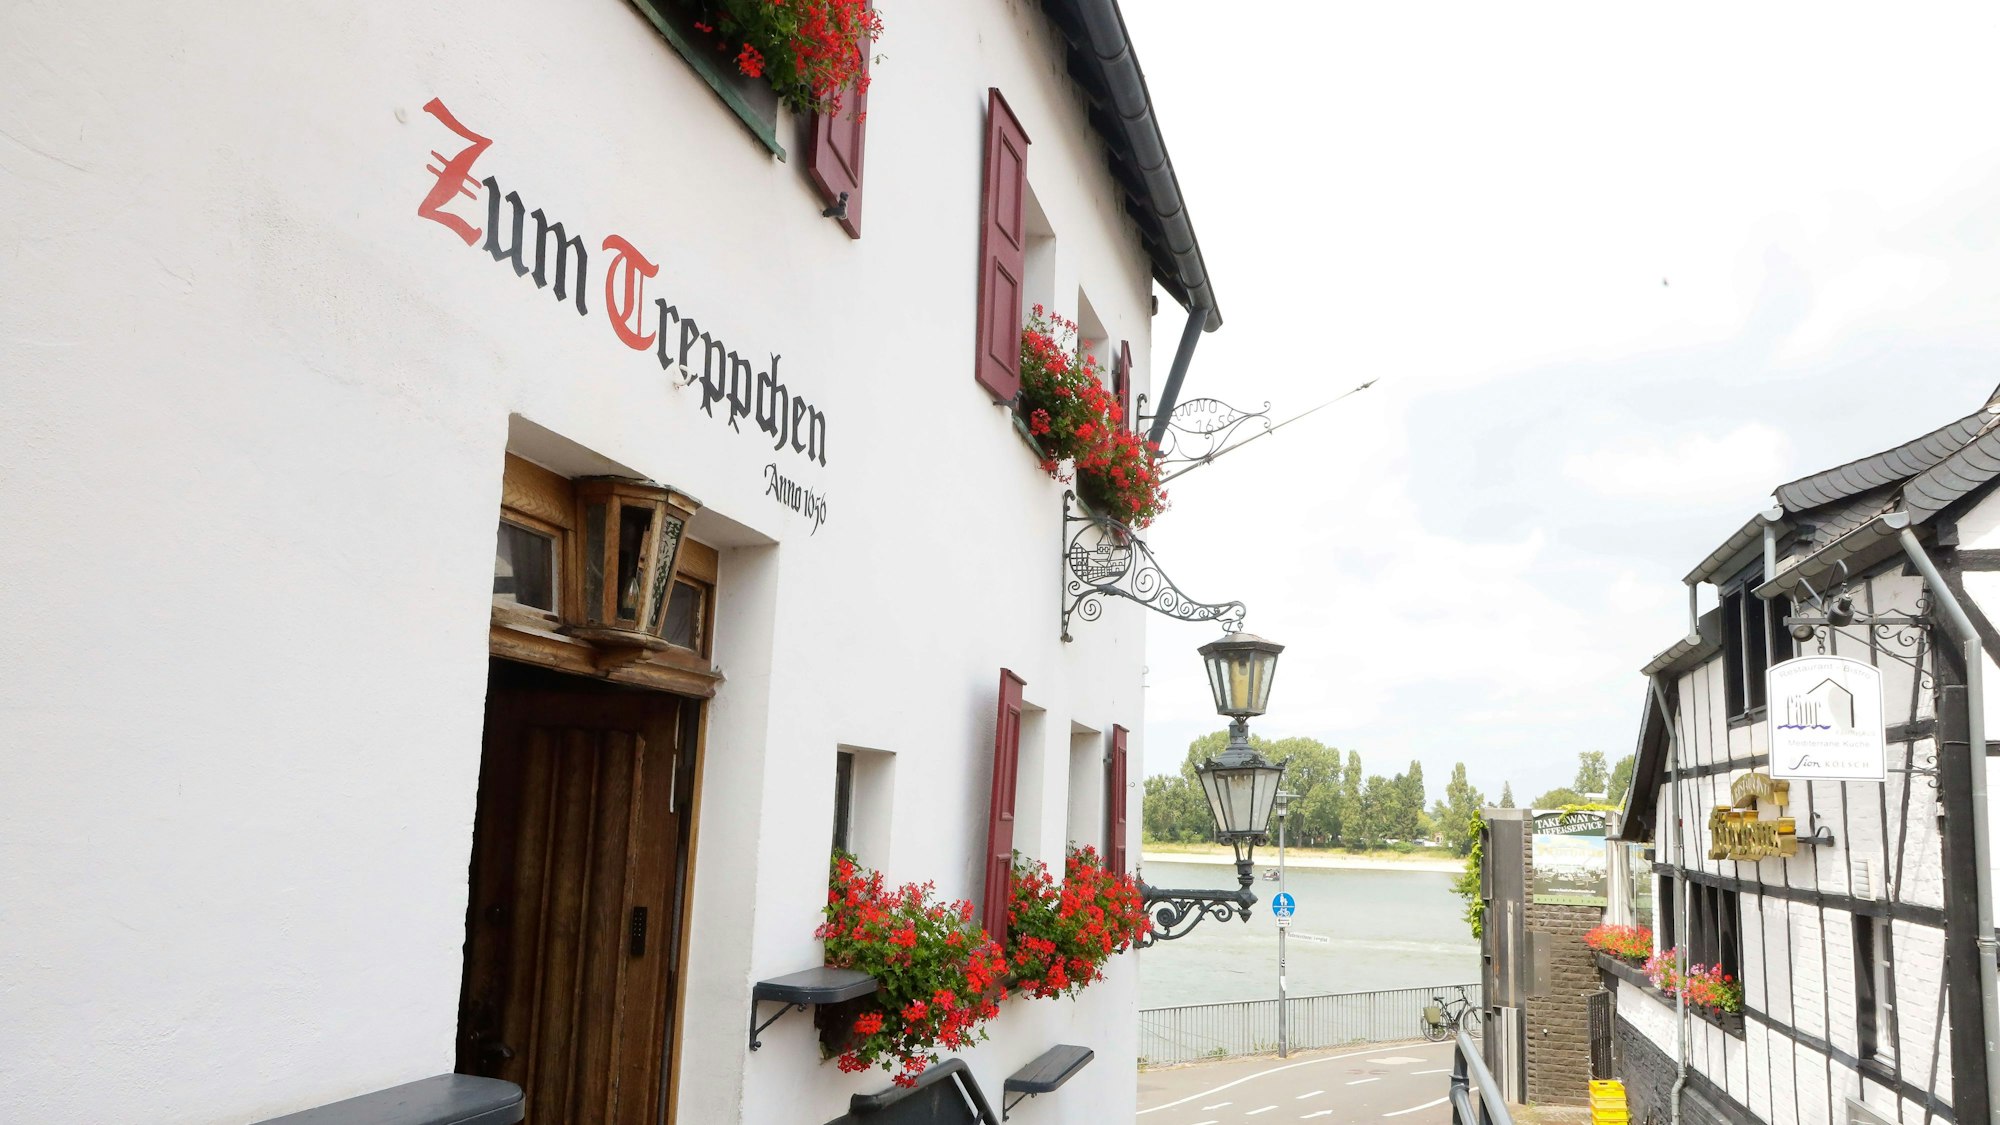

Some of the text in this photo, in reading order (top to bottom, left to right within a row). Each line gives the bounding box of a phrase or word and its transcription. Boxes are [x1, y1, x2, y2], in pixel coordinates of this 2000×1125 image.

[418, 97, 827, 467] Zum Treppchen
[1171, 399, 1217, 421] ANNO
[1195, 408, 1236, 433] 1656
[764, 462, 827, 537] Anno 1656
